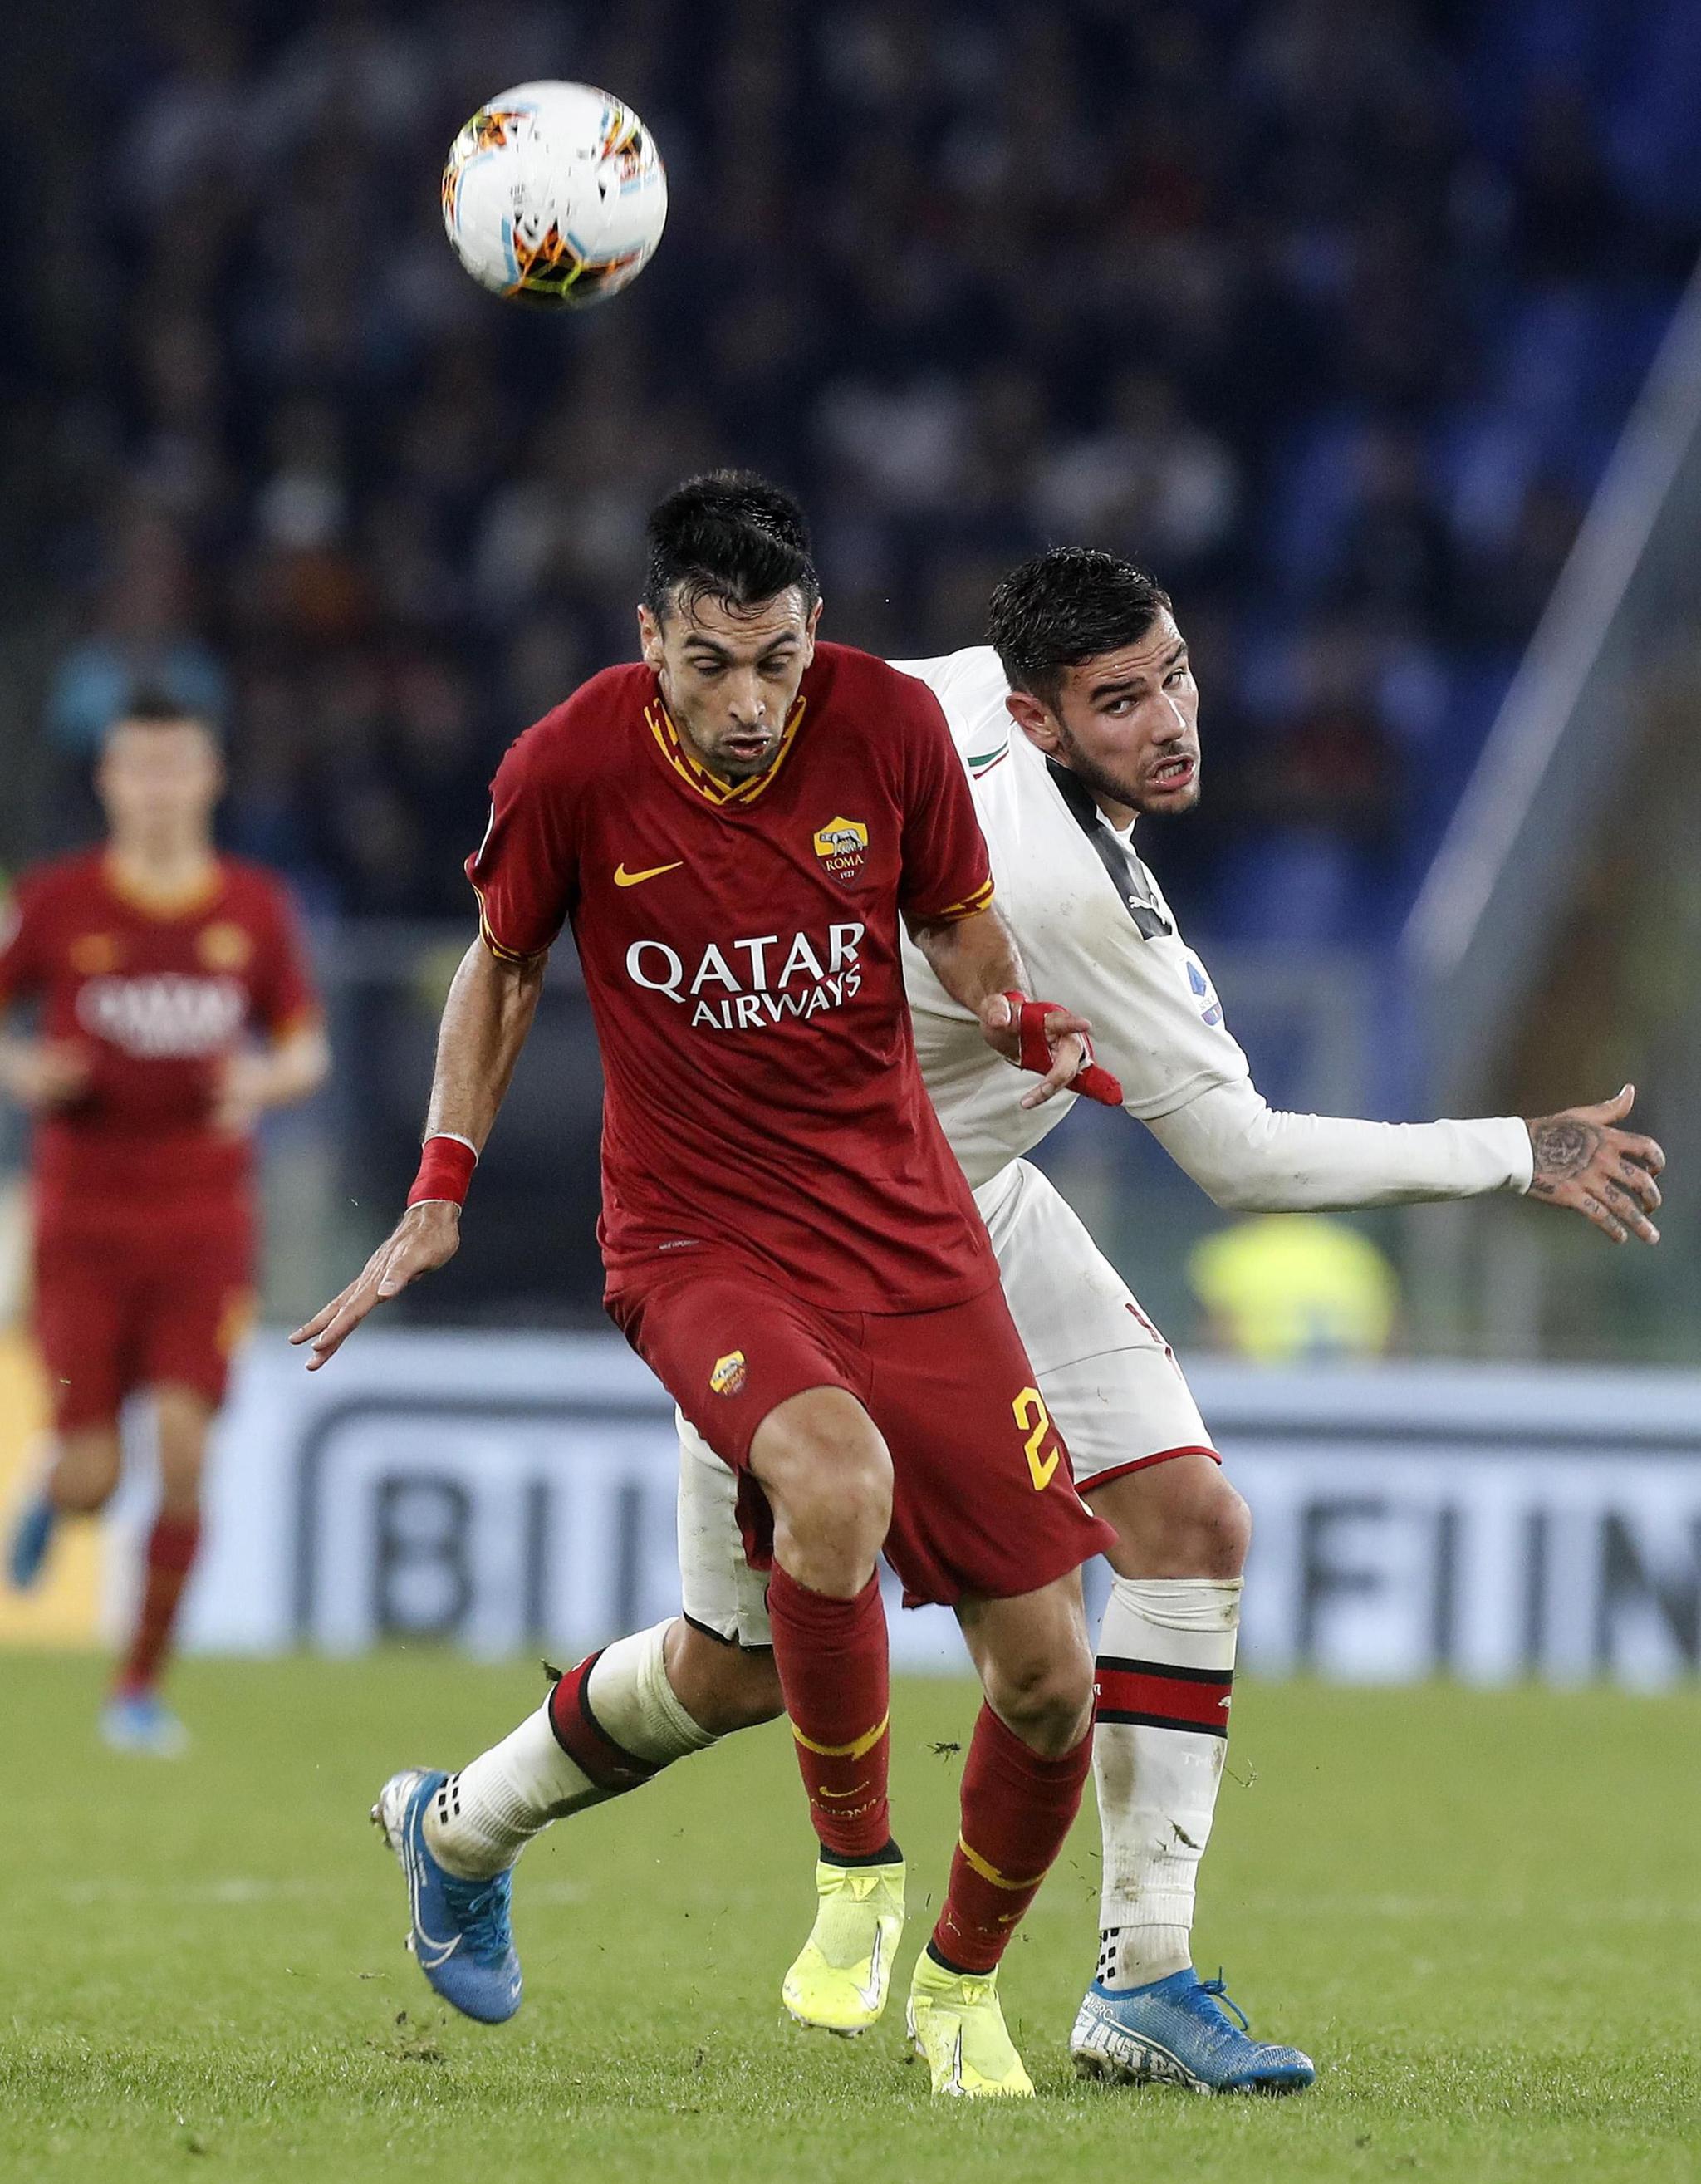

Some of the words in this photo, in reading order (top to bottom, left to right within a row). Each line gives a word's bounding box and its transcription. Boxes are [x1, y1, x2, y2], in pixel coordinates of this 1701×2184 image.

[826, 854, 864, 871] ROMA
[625, 922, 865, 1004] QATAR
[691, 964, 861, 1030] AIRWAYS
